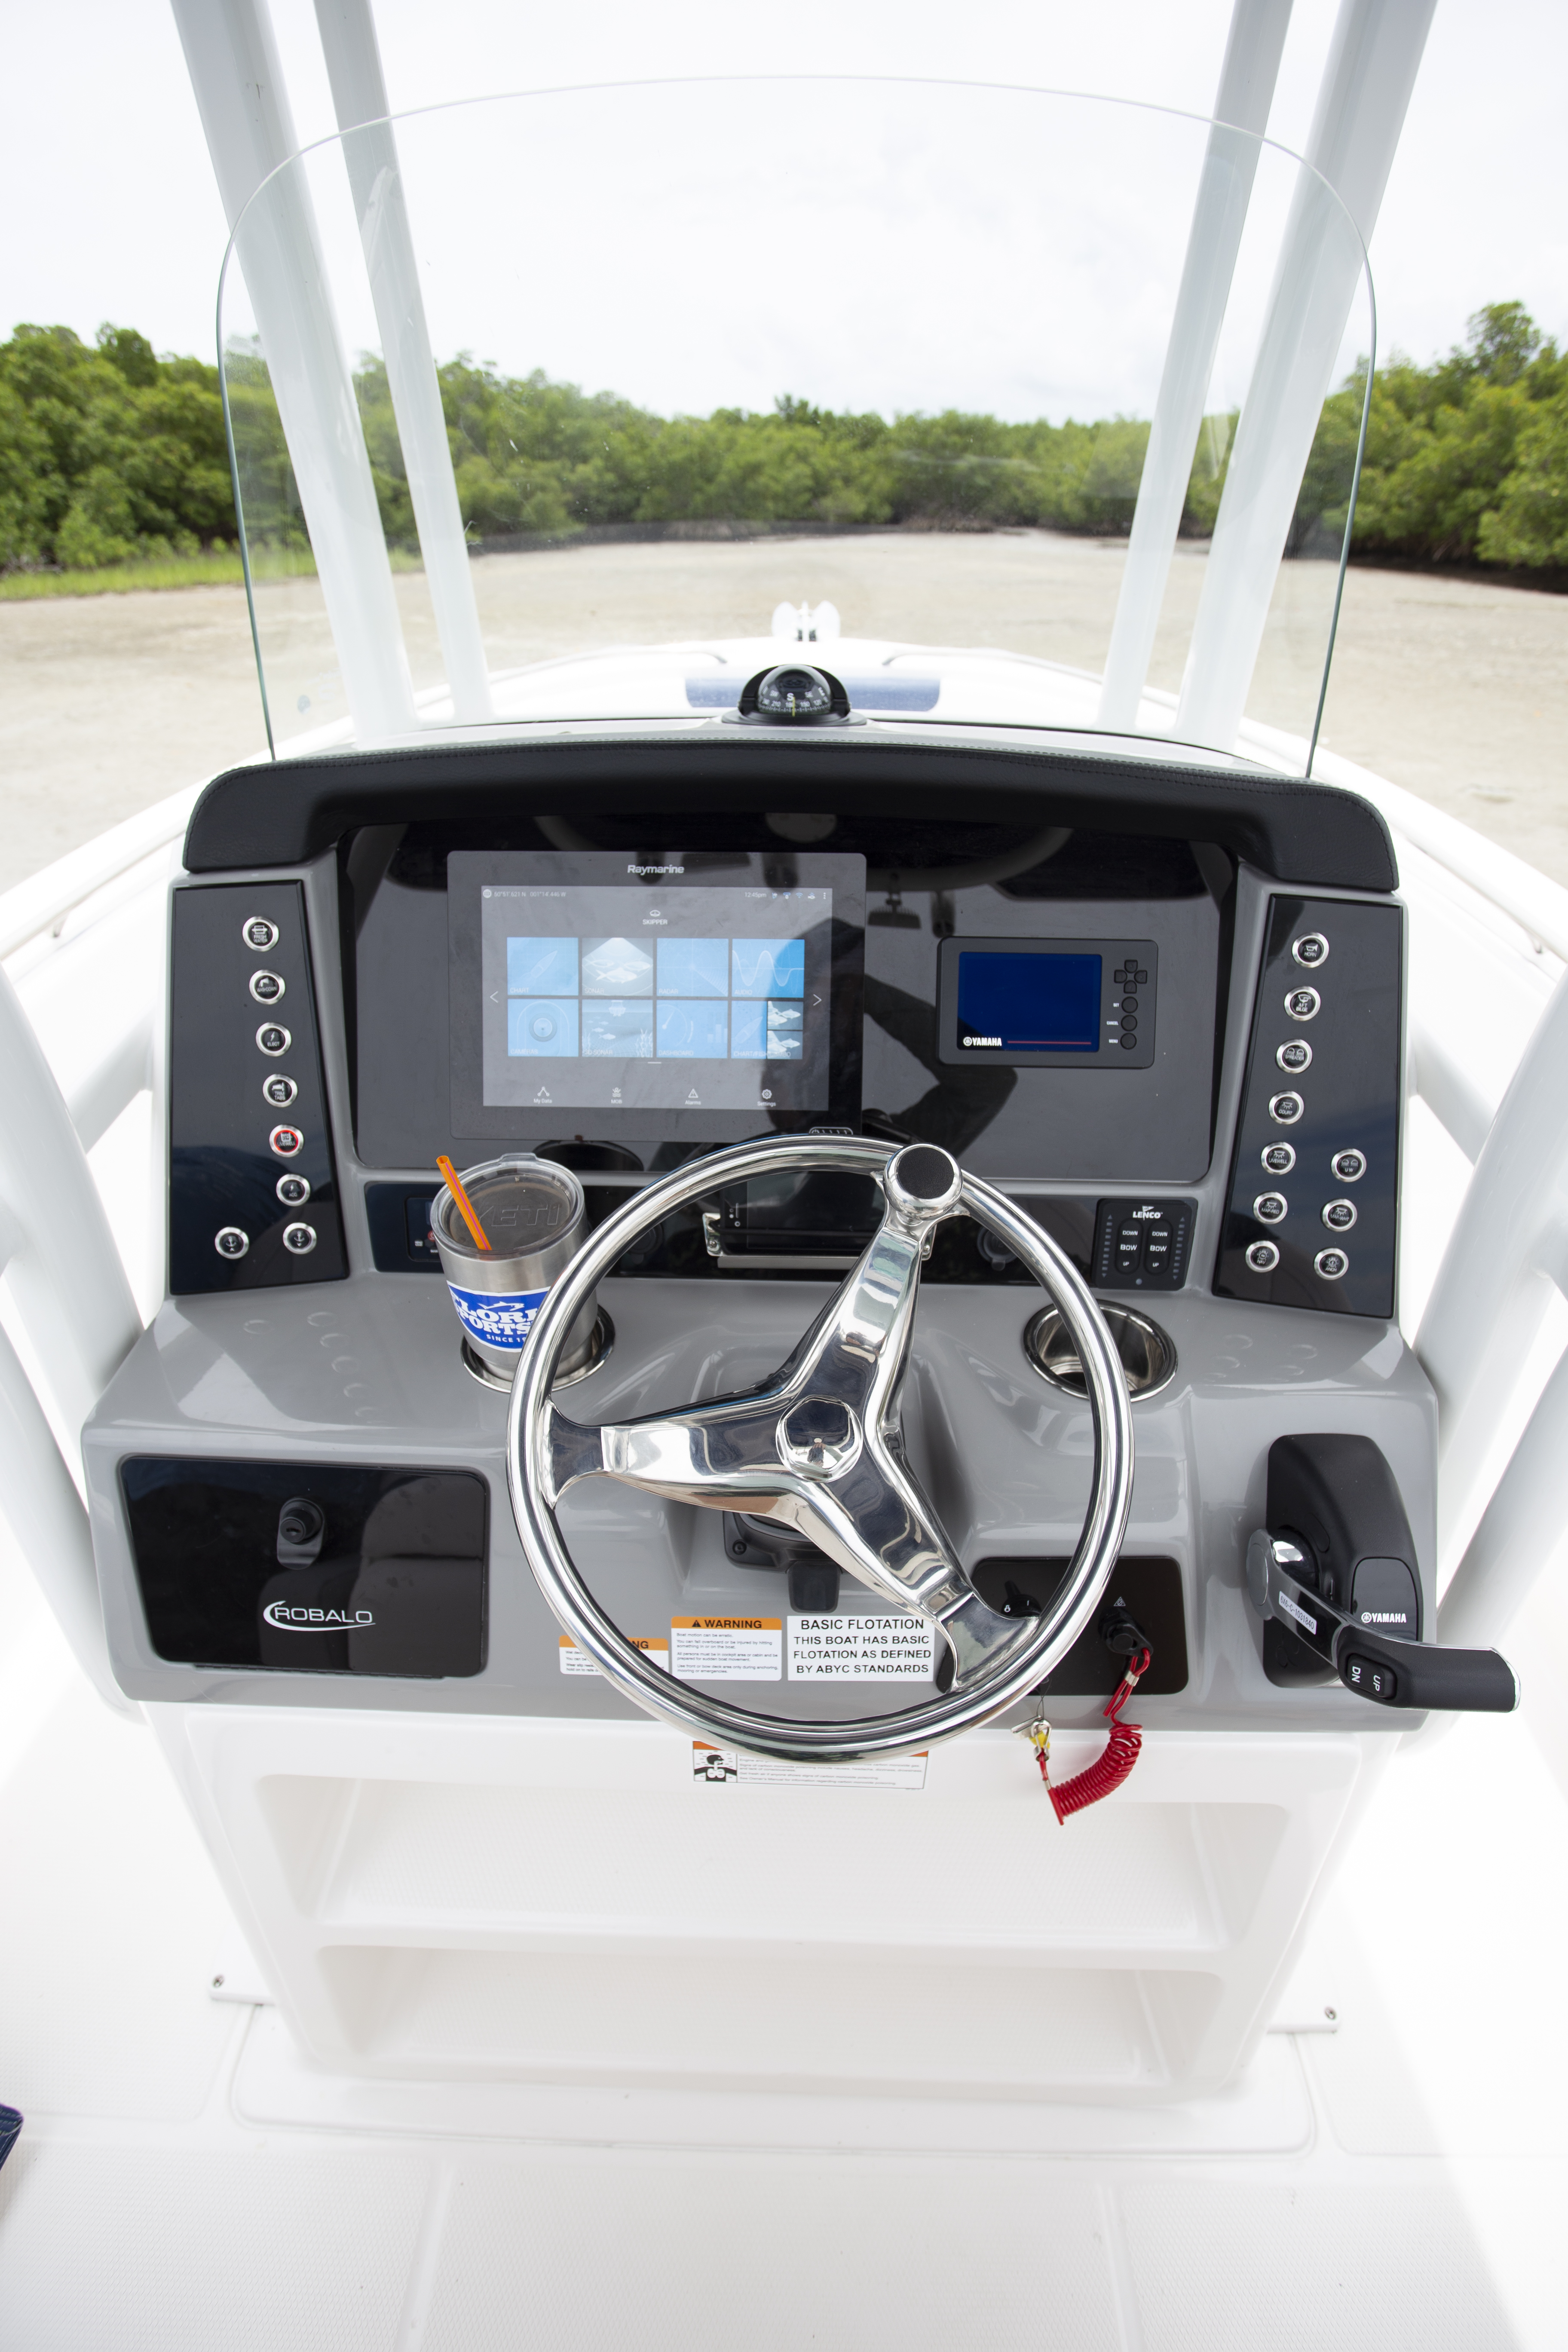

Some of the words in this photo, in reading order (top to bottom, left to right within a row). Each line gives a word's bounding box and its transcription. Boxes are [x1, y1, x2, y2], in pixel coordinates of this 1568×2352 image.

[787, 692, 794, 701] S
[627, 864, 685, 876] Raymarine
[972, 1037, 1002, 1047] YAMAHA
[1132, 1211, 1161, 1219] LENCO
[486, 1334, 514, 1342] SINCE
[274, 1607, 373, 1623] ROBALO
[1371, 1612, 1406, 1623] YAMAHA
[704, 1620, 762, 1629] WARNING
[801, 1620, 843, 1629] BASIC
[848, 1619, 924, 1629] FLOTATION
[794, 1636, 821, 1645] THIS
[826, 1636, 859, 1645] BOAT
[863, 1636, 888, 1644] HAS
[892, 1636, 929, 1644] BASIC
[794, 1651, 858, 1659] FLOTATION
[881, 1650, 931, 1658] DEFINED
[796, 1665, 813, 1673] BY
[854, 1665, 929, 1673] STANDARDS
[1351, 1666, 1361, 1682] DN
[1373, 1675, 1381, 1691] UP
